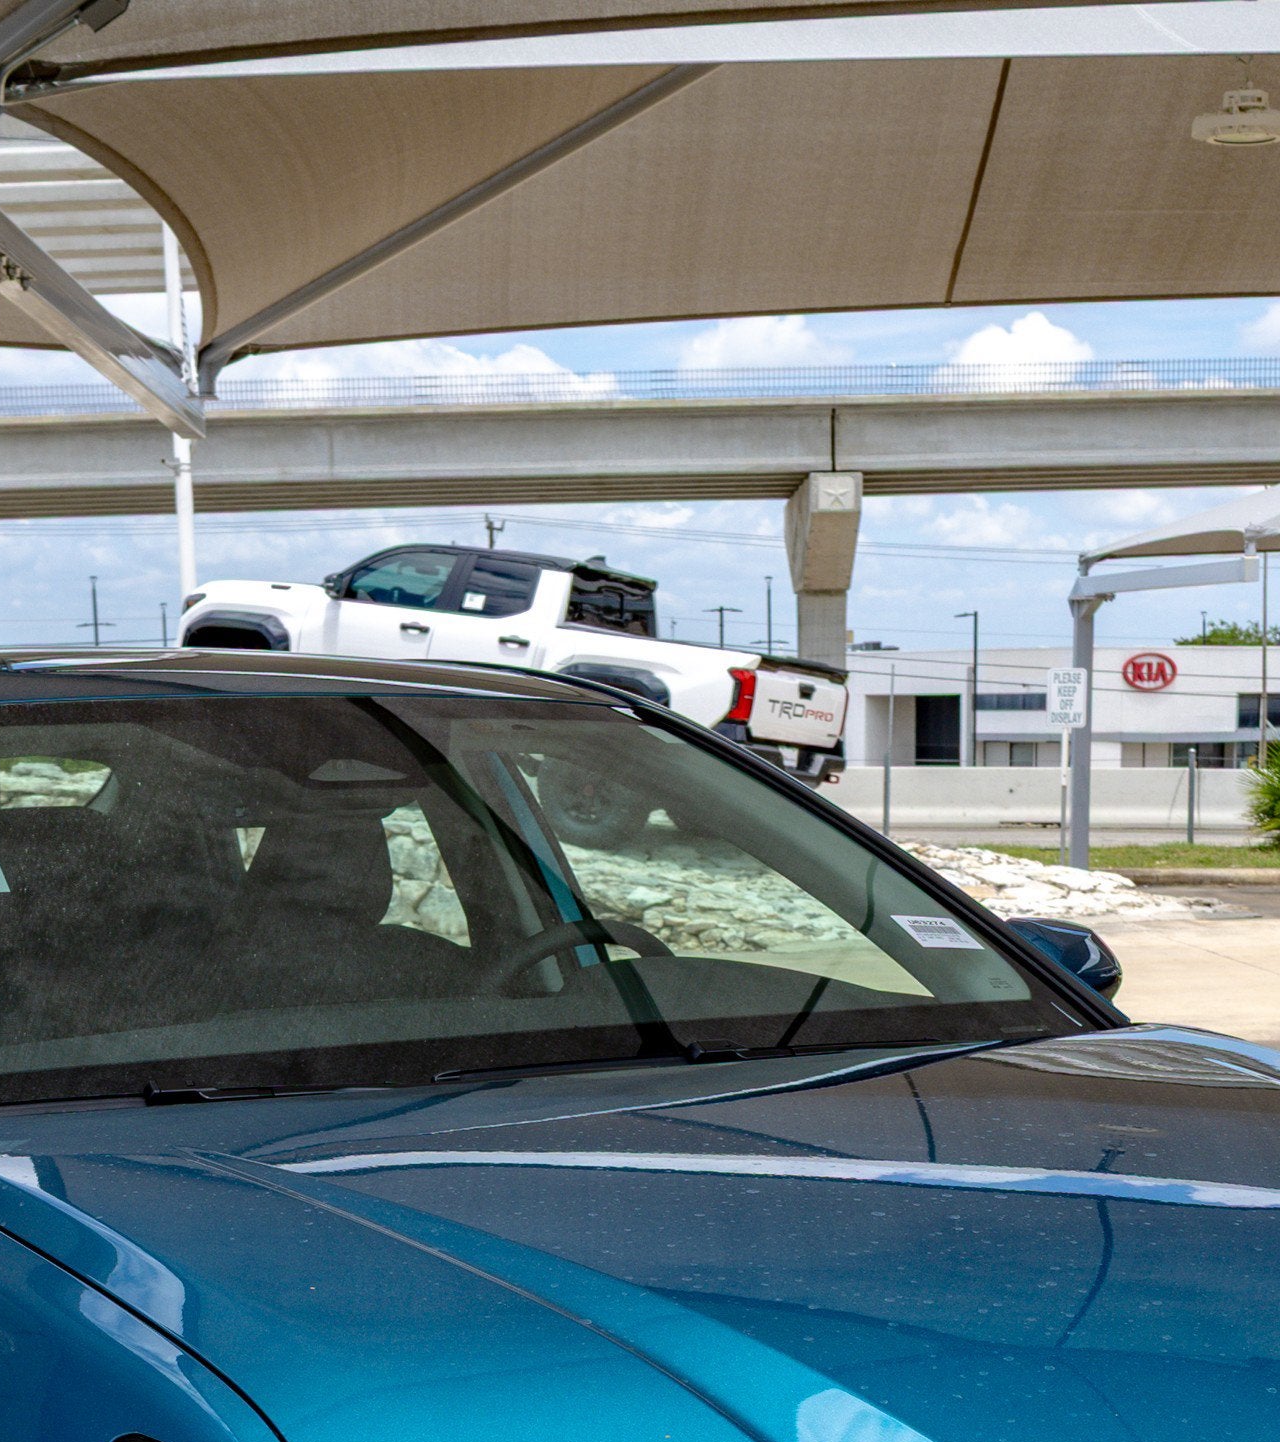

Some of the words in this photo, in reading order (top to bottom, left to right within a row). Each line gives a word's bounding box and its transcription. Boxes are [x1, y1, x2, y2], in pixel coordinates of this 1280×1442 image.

[1053, 672, 1081, 684] PLEASE
[1131, 661, 1169, 686] KIA
[1057, 686, 1077, 697] KEEP
[1060, 699, 1074, 710] OFF
[769, 699, 806, 719] TRD
[805, 709, 834, 722] PRO
[1050, 712, 1082, 723] DISPLAY
